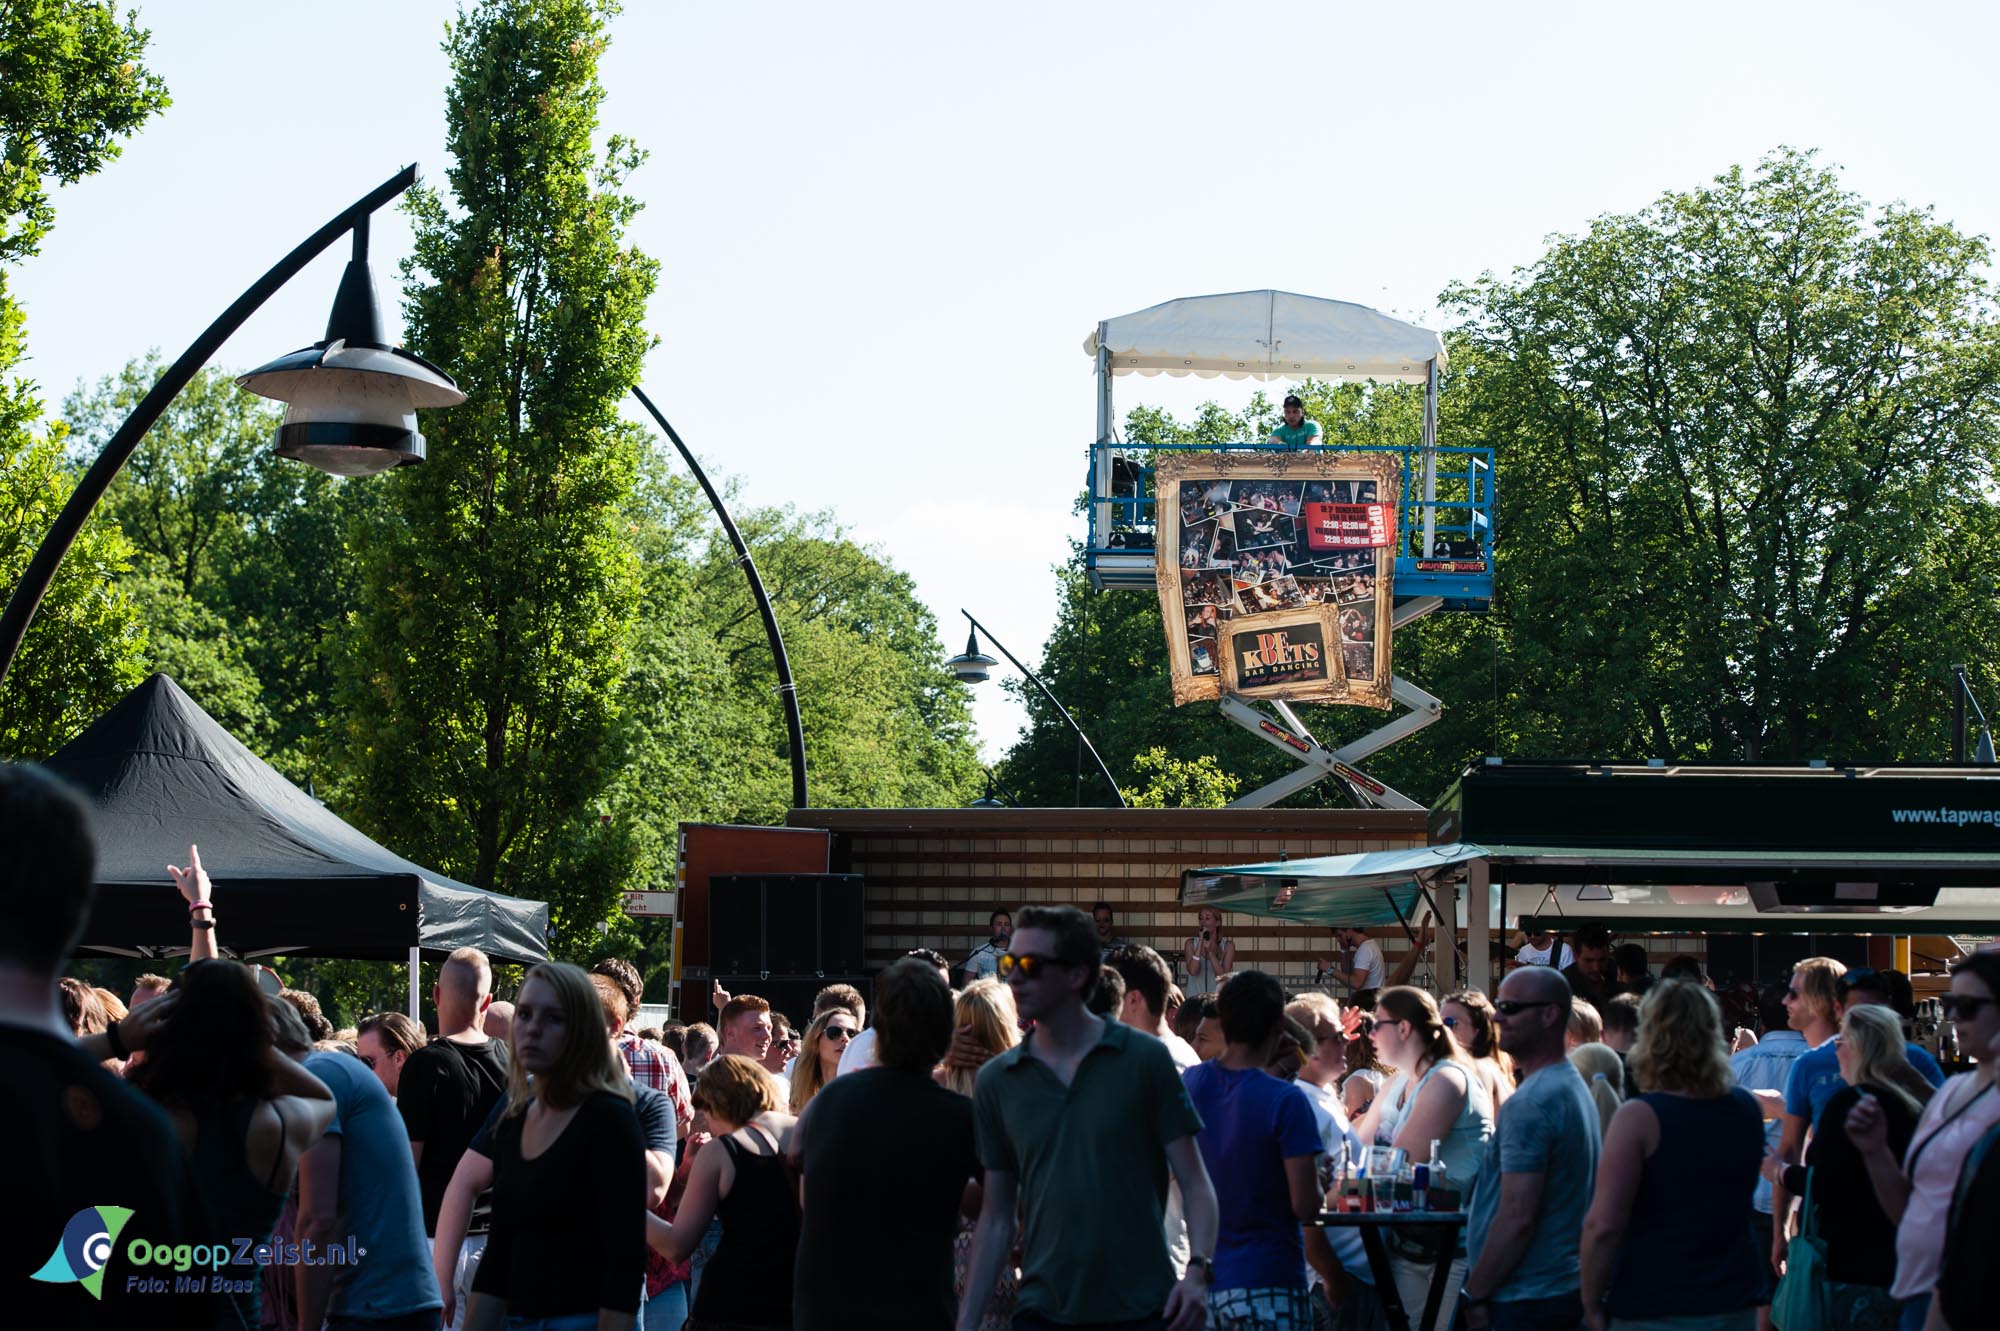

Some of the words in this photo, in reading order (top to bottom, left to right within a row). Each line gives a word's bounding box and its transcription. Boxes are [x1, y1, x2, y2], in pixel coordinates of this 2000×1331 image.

[1368, 505, 1385, 544] OPEN
[1242, 642, 1319, 669] KOETS
[1245, 669, 1264, 677] BAR
[1272, 661, 1319, 672] DANCING
